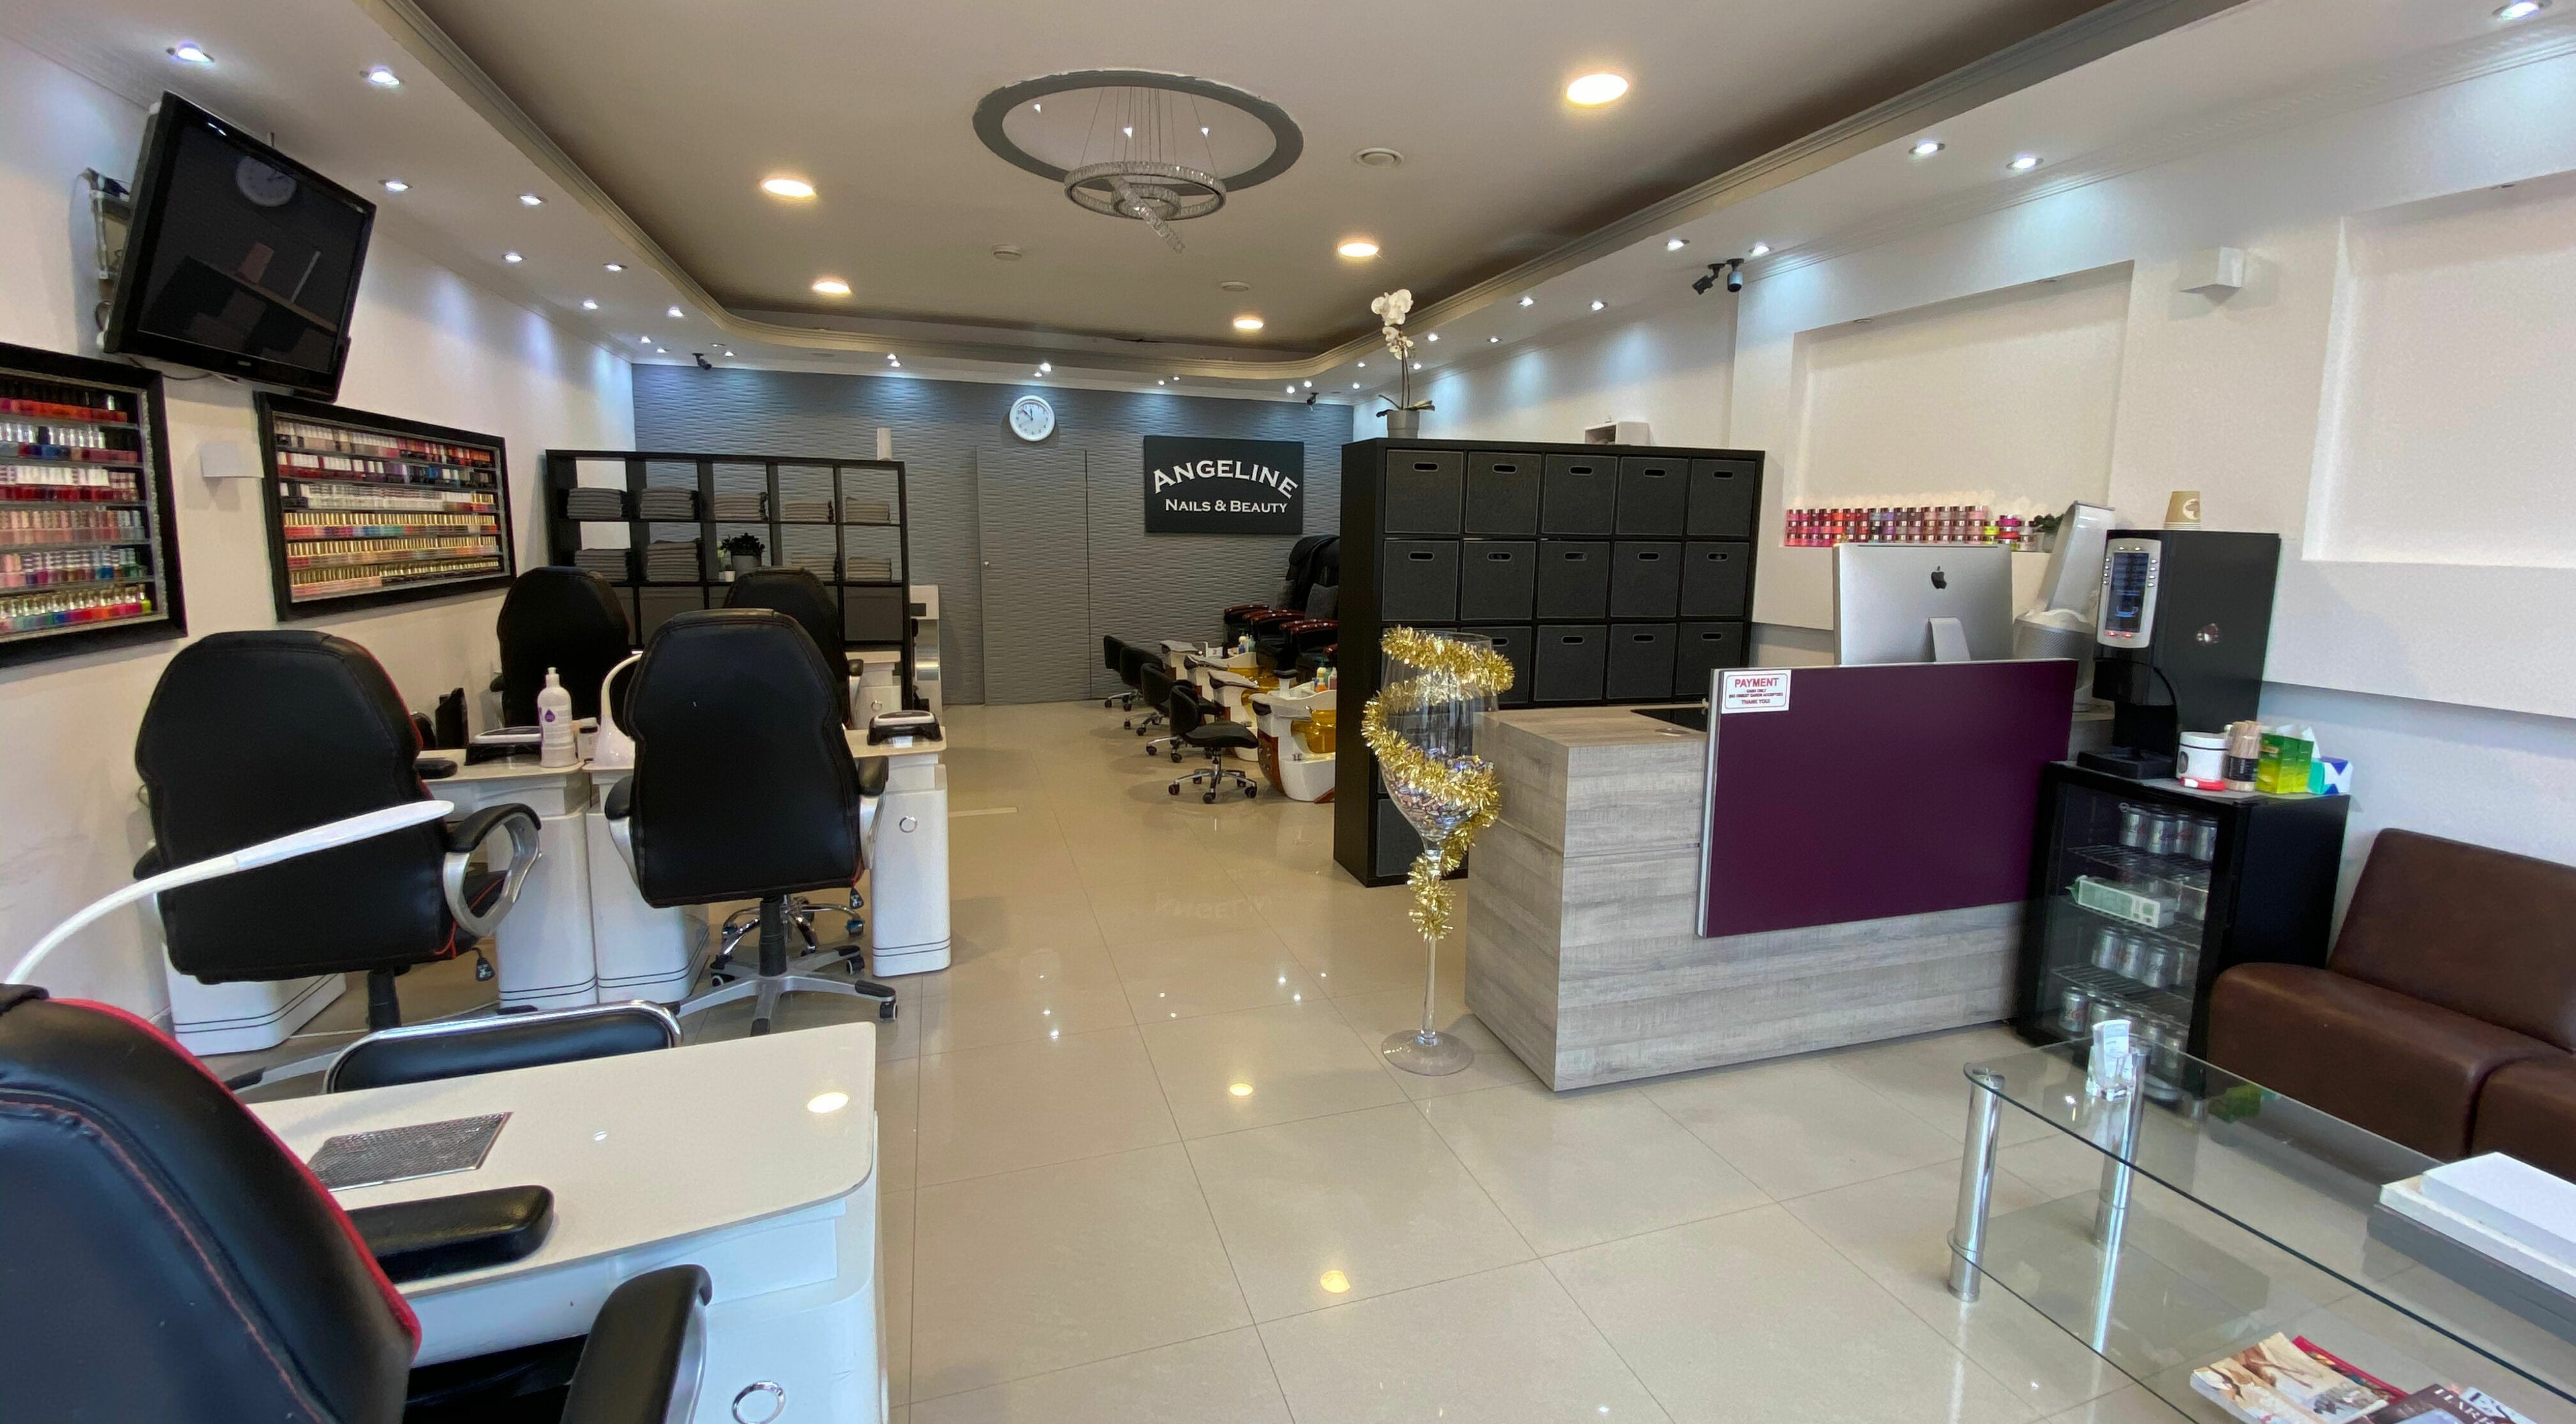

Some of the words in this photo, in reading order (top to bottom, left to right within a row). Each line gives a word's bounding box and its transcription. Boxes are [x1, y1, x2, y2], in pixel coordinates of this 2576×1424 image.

[1153, 459, 1299, 500] ANGELINE
[1214, 500, 1227, 512] &
[1734, 677, 1779, 688] PAYMENT
